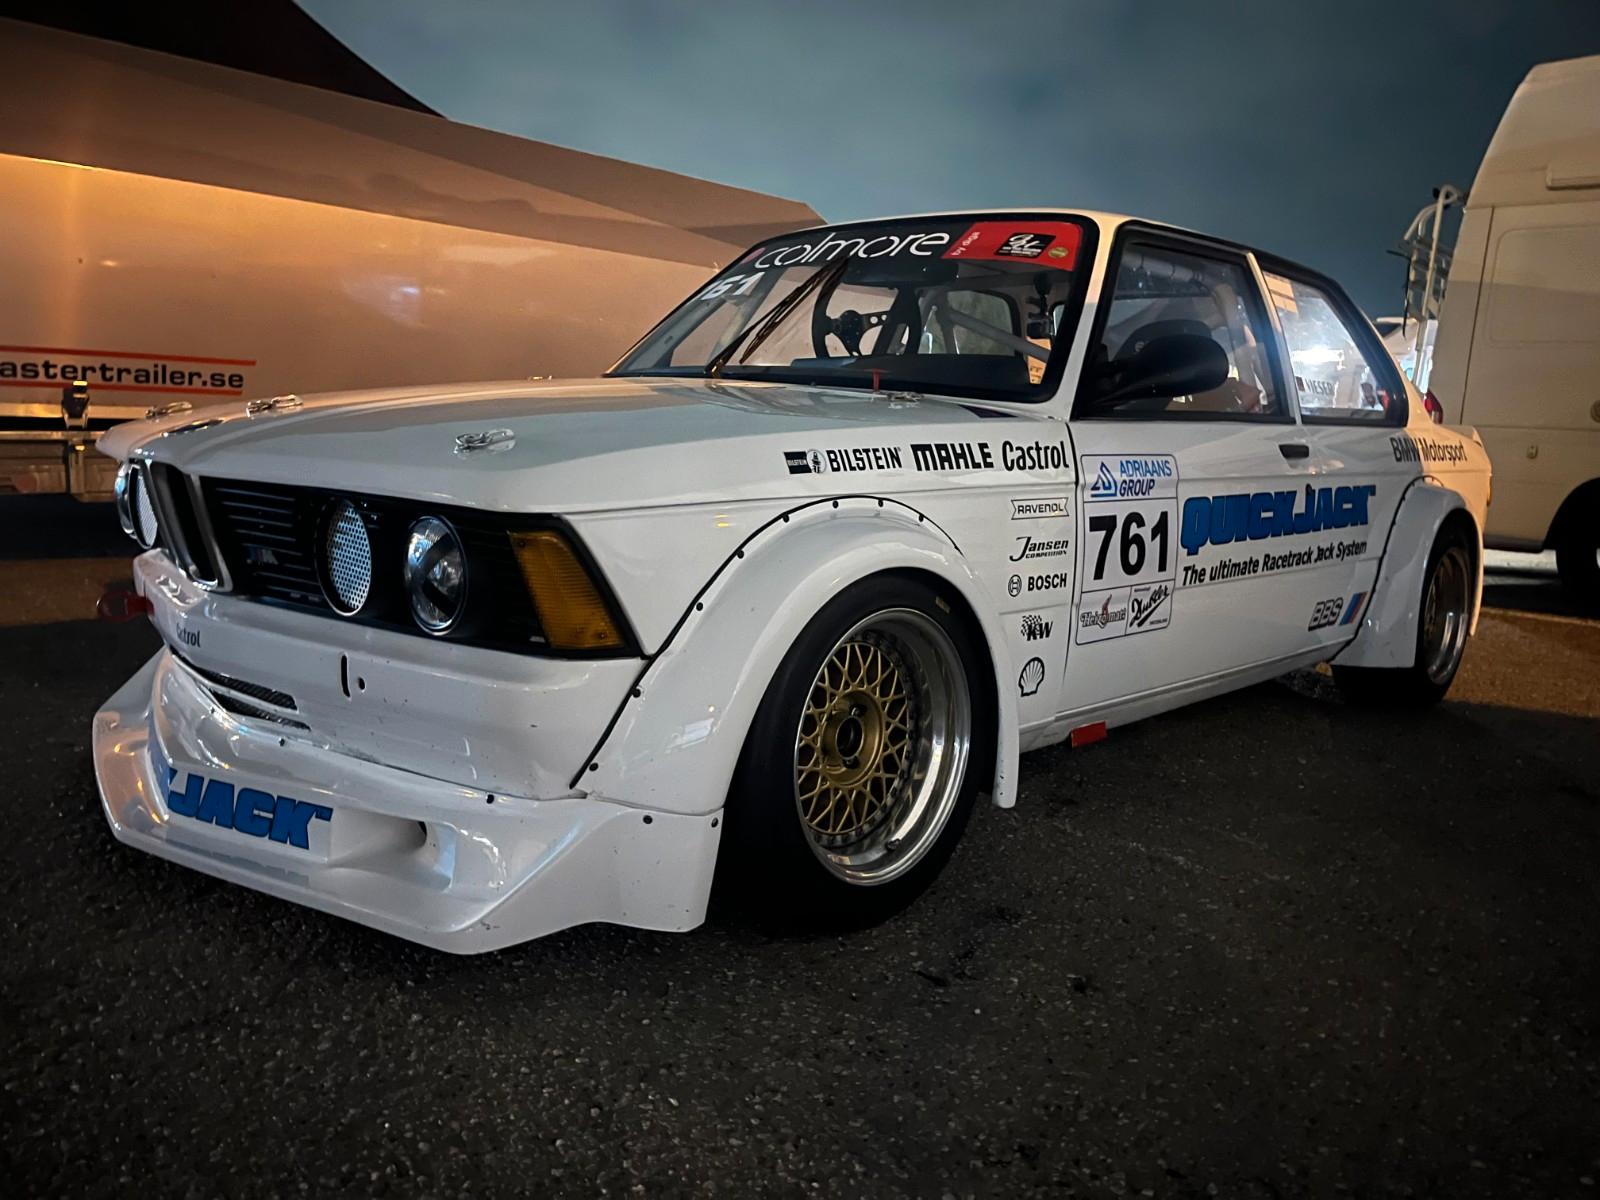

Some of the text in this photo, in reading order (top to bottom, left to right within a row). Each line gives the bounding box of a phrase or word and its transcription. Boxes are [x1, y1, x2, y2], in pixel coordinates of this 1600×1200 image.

[754, 231, 951, 270] colmore
[826, 446, 902, 473] BILSTEIN
[910, 442, 994, 471] MAHLE
[1002, 440, 1070, 472] Castrol
[1391, 436, 1468, 467] BMW Motorsport
[1119, 459, 1172, 478] ADRIAANS
[1119, 479, 1155, 497] GROUP
[1017, 502, 1064, 515] RAVENOL
[1180, 484, 1376, 556] QUICKJACK
[1009, 536, 1069, 562] Jansen
[1089, 510, 1169, 581] 761
[1182, 540, 1367, 587] The ultimate Racetrack Jack System
[1027, 573, 1068, 592] BOSCH
[1308, 597, 1344, 631] BBS
[168, 767, 334, 850] JACK
